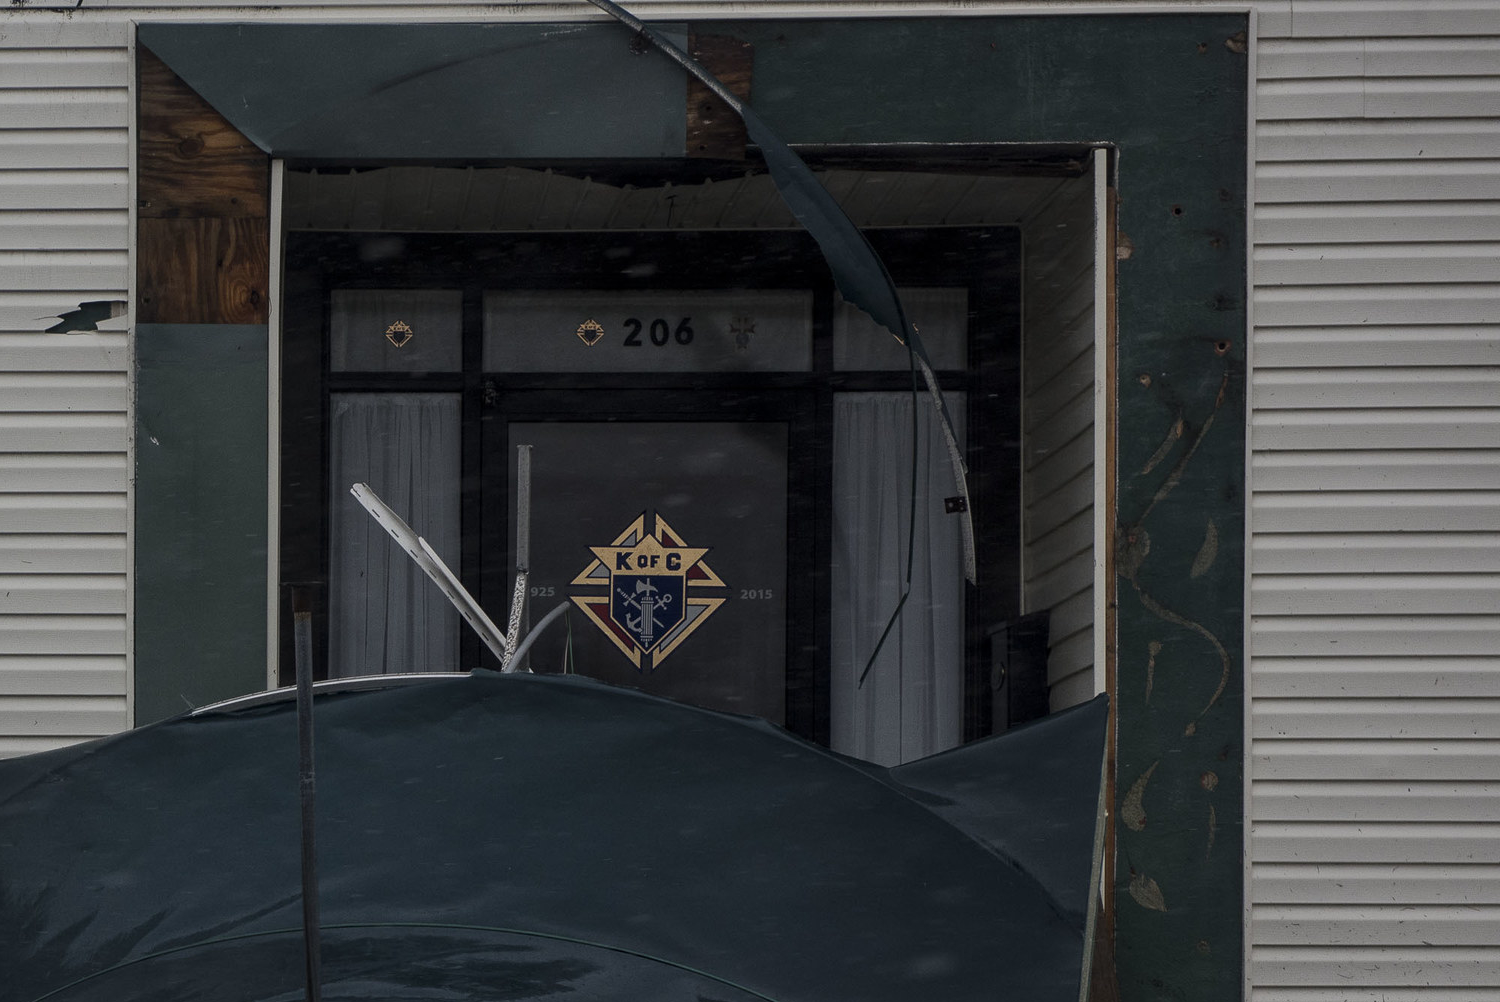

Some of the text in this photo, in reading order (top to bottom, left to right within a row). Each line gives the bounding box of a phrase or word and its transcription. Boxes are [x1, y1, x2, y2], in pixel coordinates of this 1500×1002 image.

[623, 317, 694, 347] 206
[616, 552, 633, 570] K
[666, 552, 682, 571] C
[530, 586, 555, 597] 925
[740, 588, 773, 600] 2015
